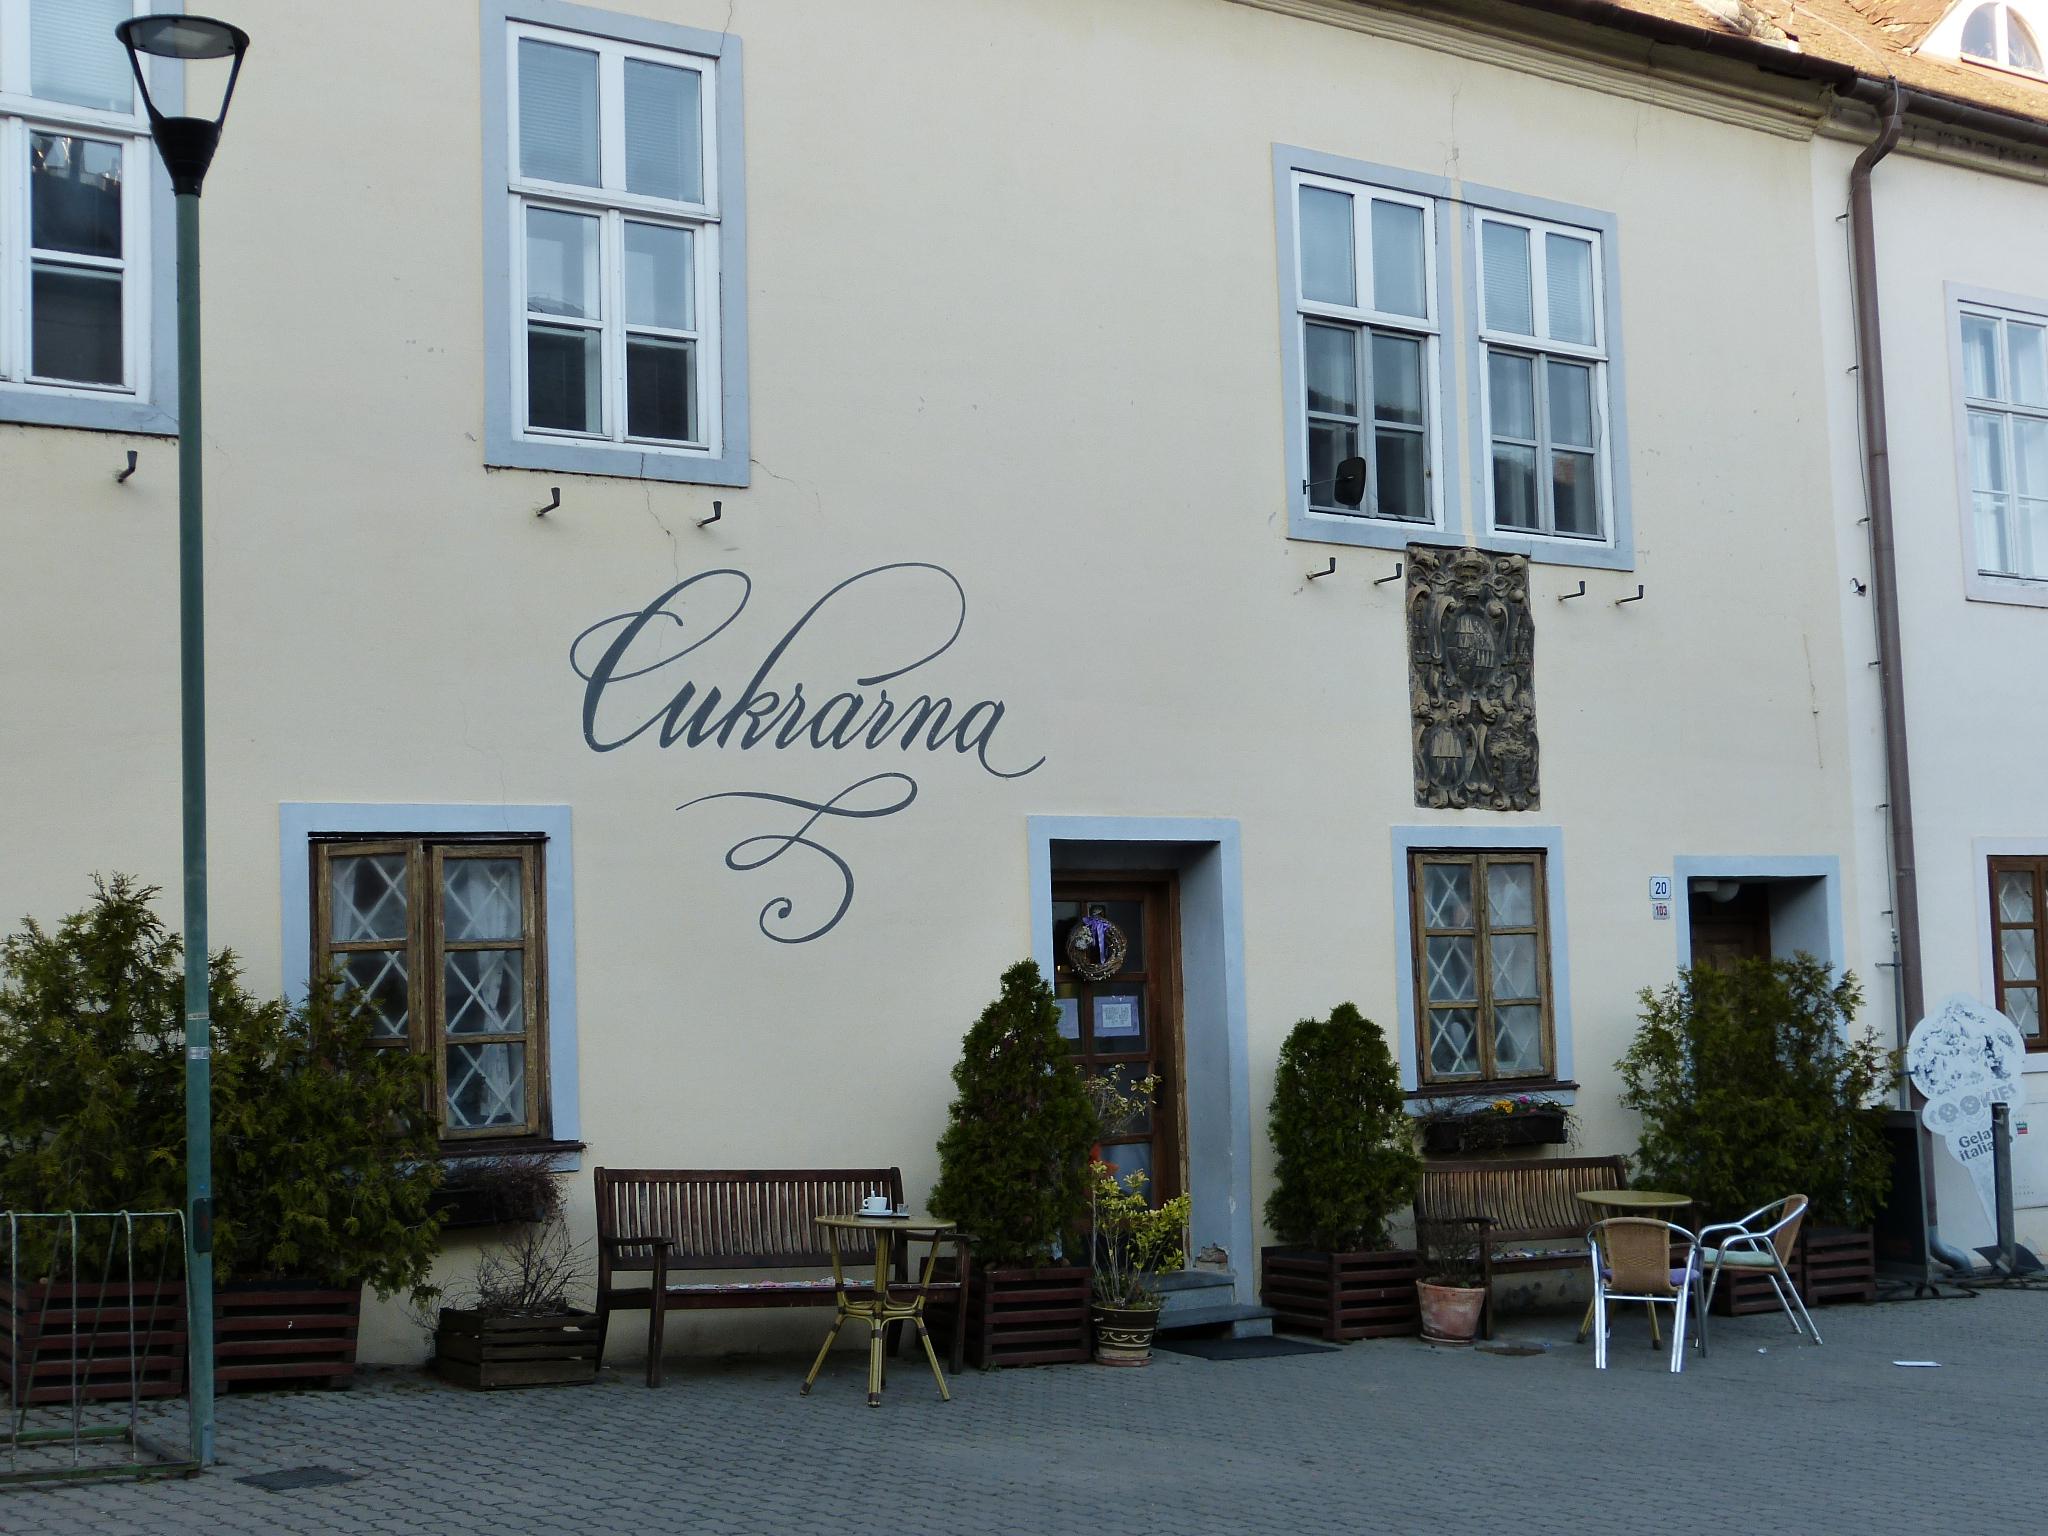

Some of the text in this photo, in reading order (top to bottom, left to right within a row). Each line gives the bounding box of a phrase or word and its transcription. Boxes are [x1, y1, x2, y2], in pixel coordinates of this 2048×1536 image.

[569, 562, 1046, 779] Cukrárna
[1655, 881, 1667, 895] 20
[1655, 905, 1668, 916] 103
[1928, 1083, 2017, 1123] COOKIES
